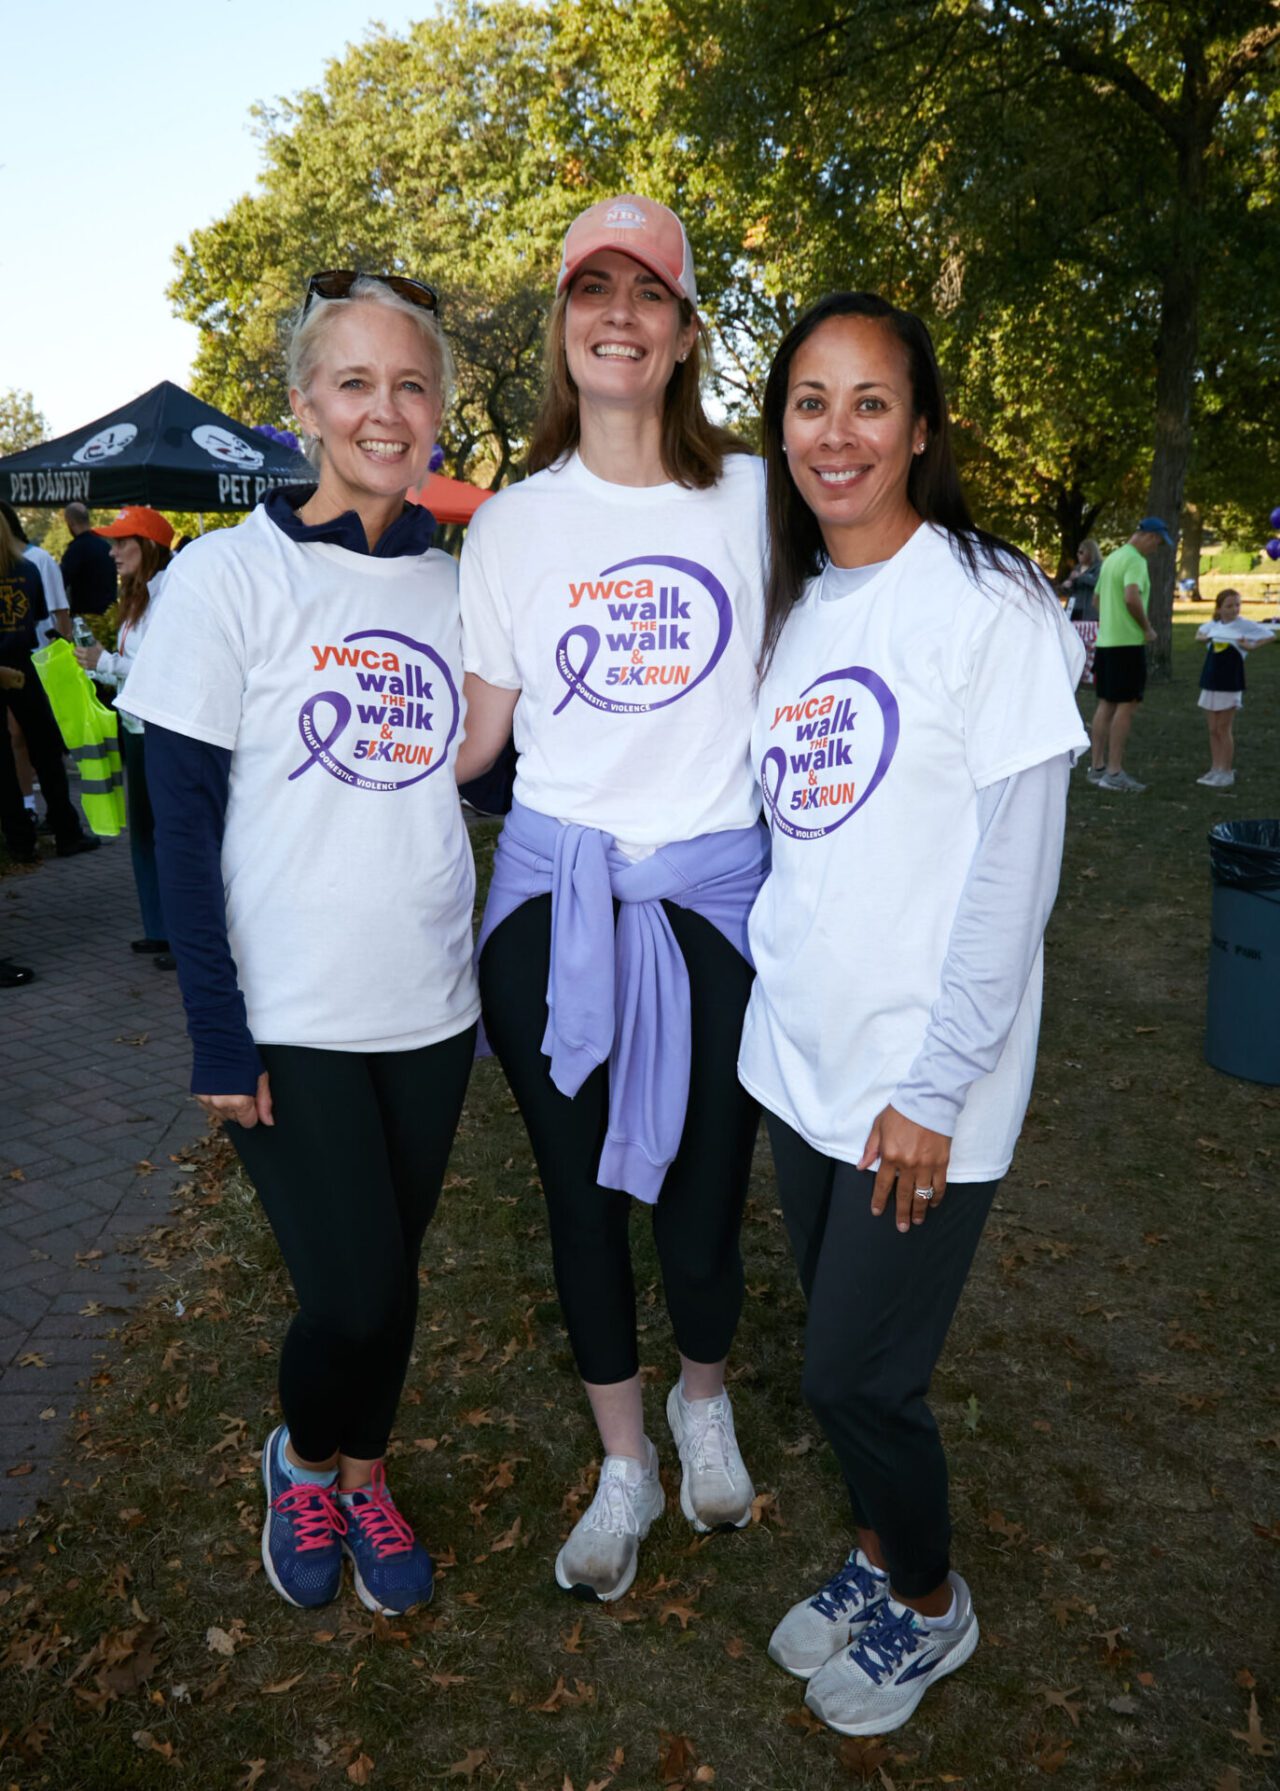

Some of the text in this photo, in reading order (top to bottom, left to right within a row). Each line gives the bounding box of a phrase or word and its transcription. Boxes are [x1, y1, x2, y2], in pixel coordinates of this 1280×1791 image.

[10, 469, 90, 502] PET PANTRY
[218, 473, 251, 505] PET
[568, 578, 654, 608] ywca
[607, 586, 691, 621] walk
[605, 624, 690, 651] walk
[631, 621, 657, 631] THE
[311, 645, 400, 672] ywca
[631, 649, 644, 665] &
[356, 663, 434, 700] walk
[558, 649, 651, 713] AGAINST DOMESTIC VIOLENCE
[381, 694, 406, 707] THE
[770, 695, 836, 731] ywca
[356, 702, 434, 731] walk
[796, 698, 858, 742] walk
[380, 723, 393, 740] &
[810, 737, 828, 750] THE
[302, 713, 398, 790] AGAINST DOMESTIC VIOLENCE
[789, 738, 853, 774] walk
[808, 769, 818, 785] &
[796, 828, 826, 839] VIOLENCE
